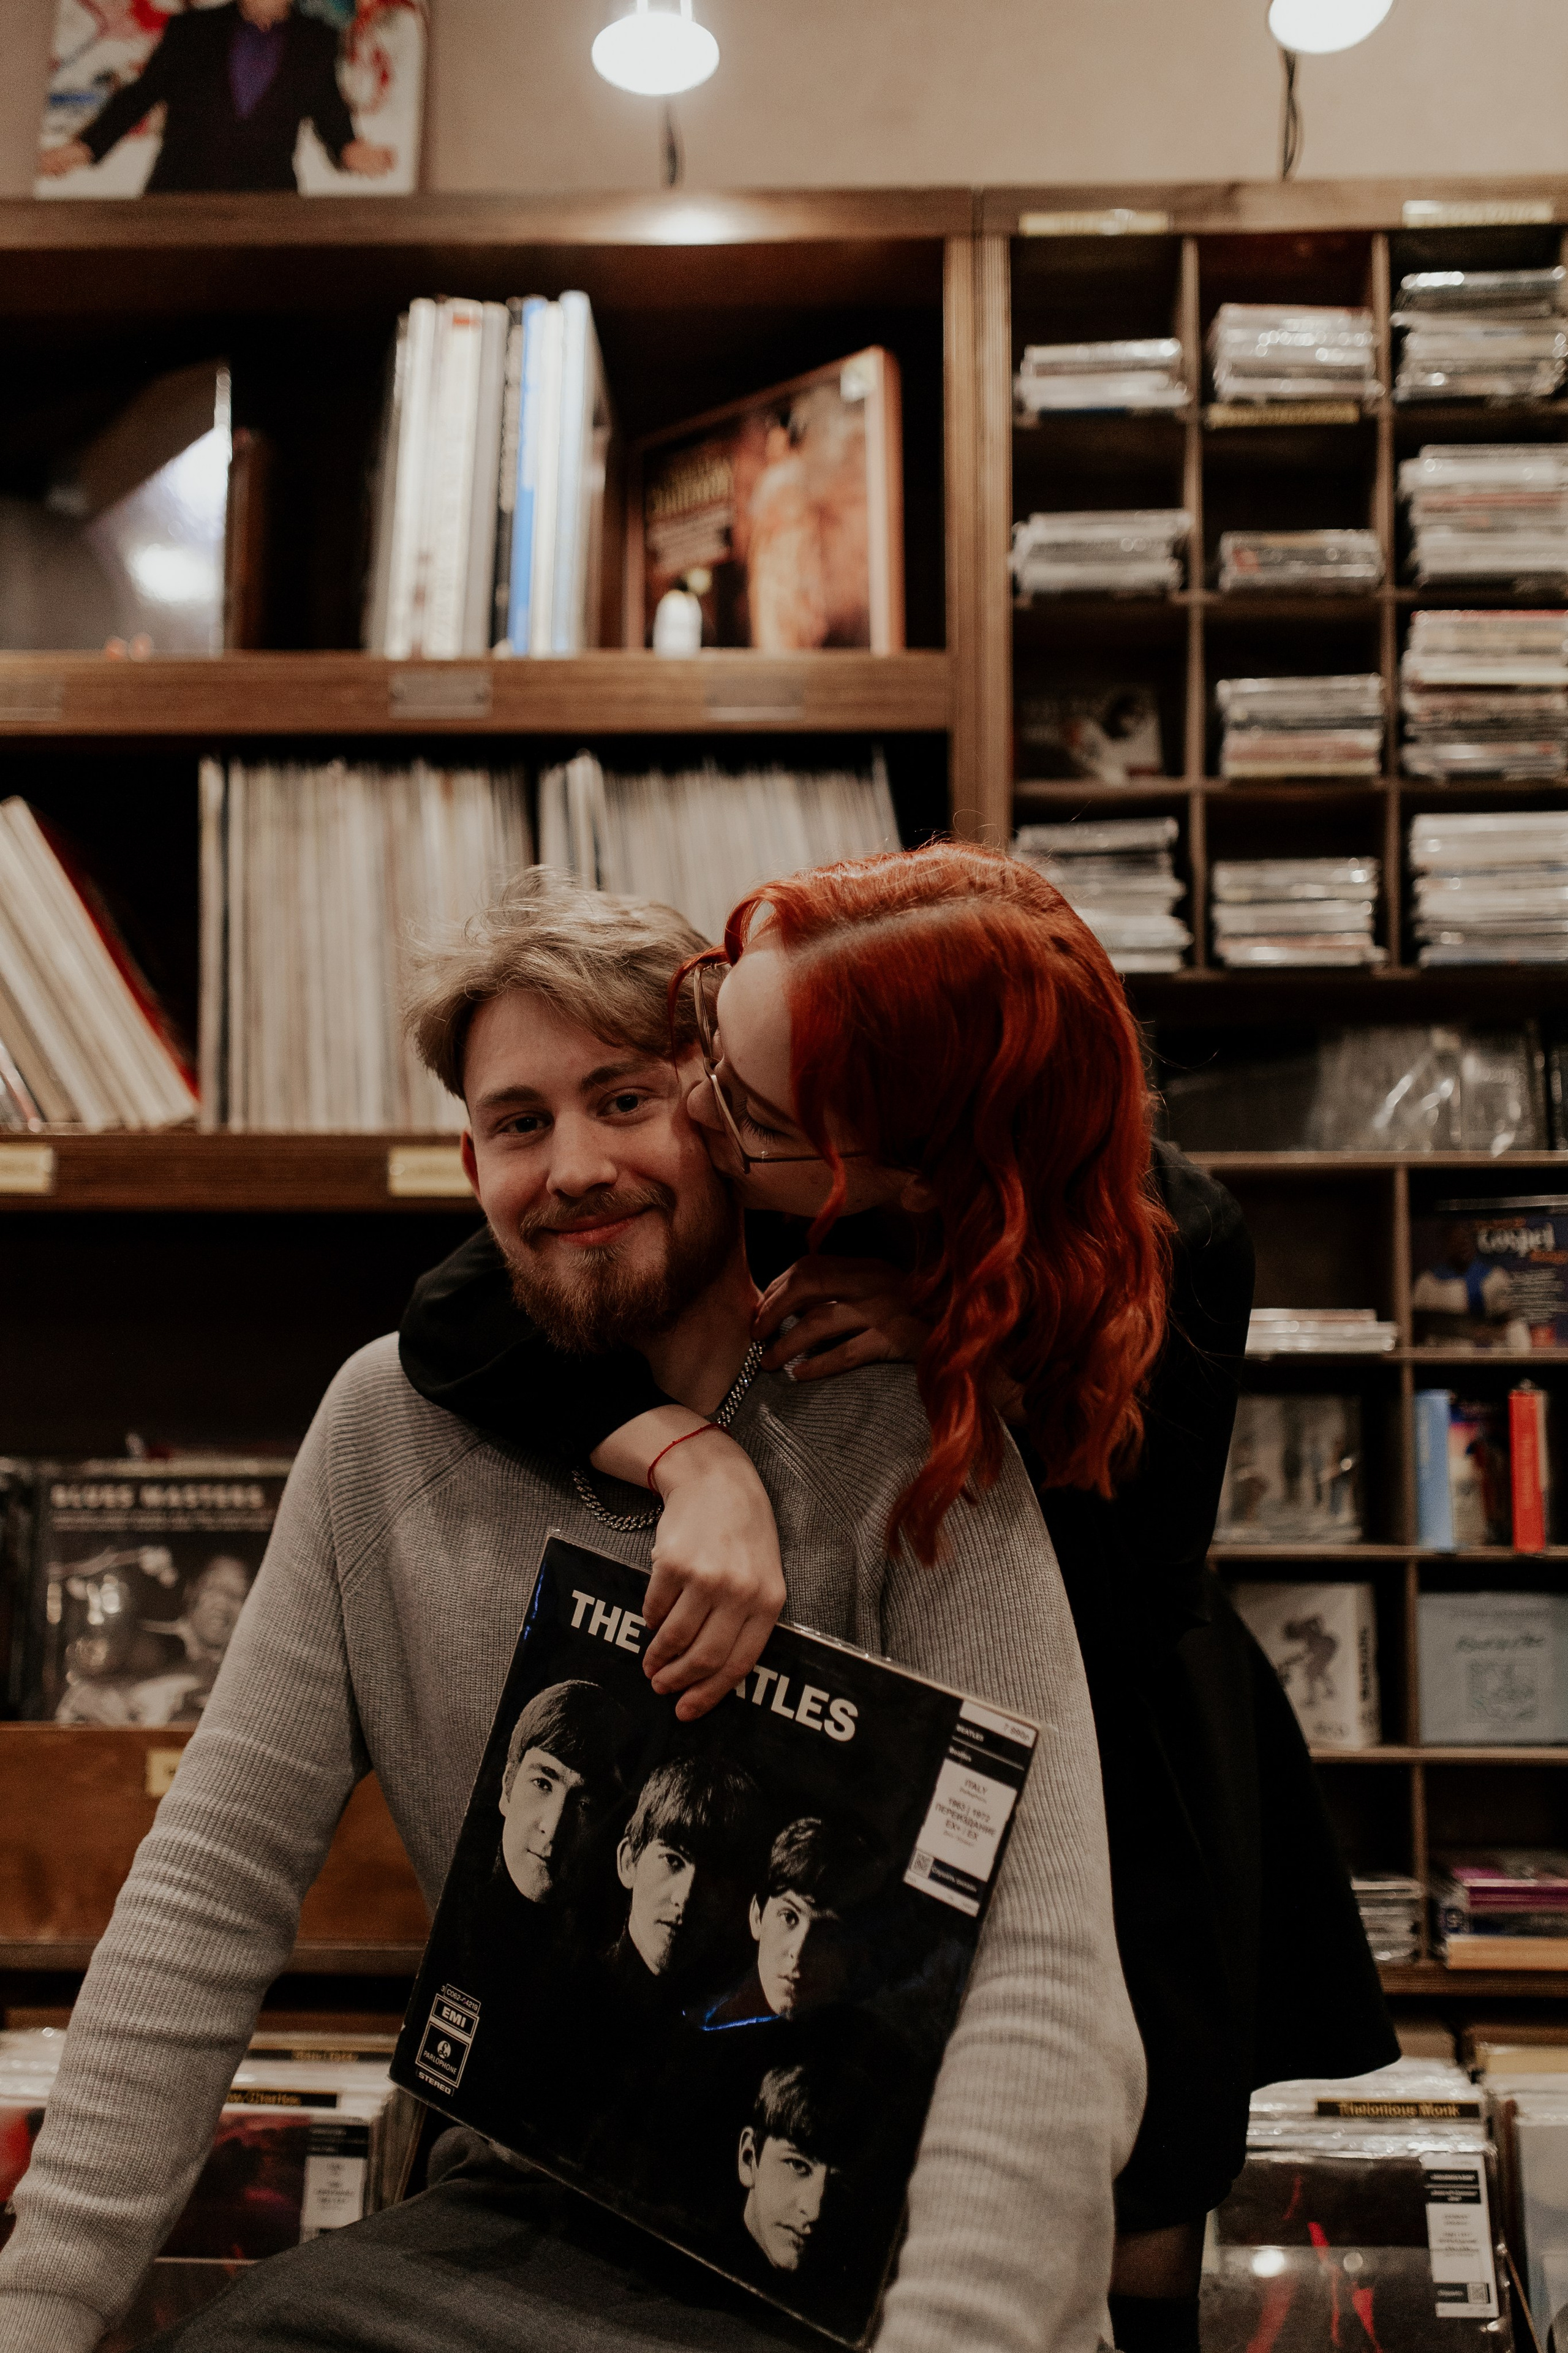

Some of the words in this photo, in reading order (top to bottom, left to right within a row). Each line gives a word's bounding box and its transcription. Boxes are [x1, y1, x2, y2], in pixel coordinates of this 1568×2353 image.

[570, 1590, 647, 1654] THE
[734, 1664, 859, 1742] TLES
[965, 1778, 987, 1795] ITALY
[442, 2006, 466, 2028] EMI
[423, 2050, 458, 2075] PARLOPHONE
[418, 2071, 451, 2095] STEREO
